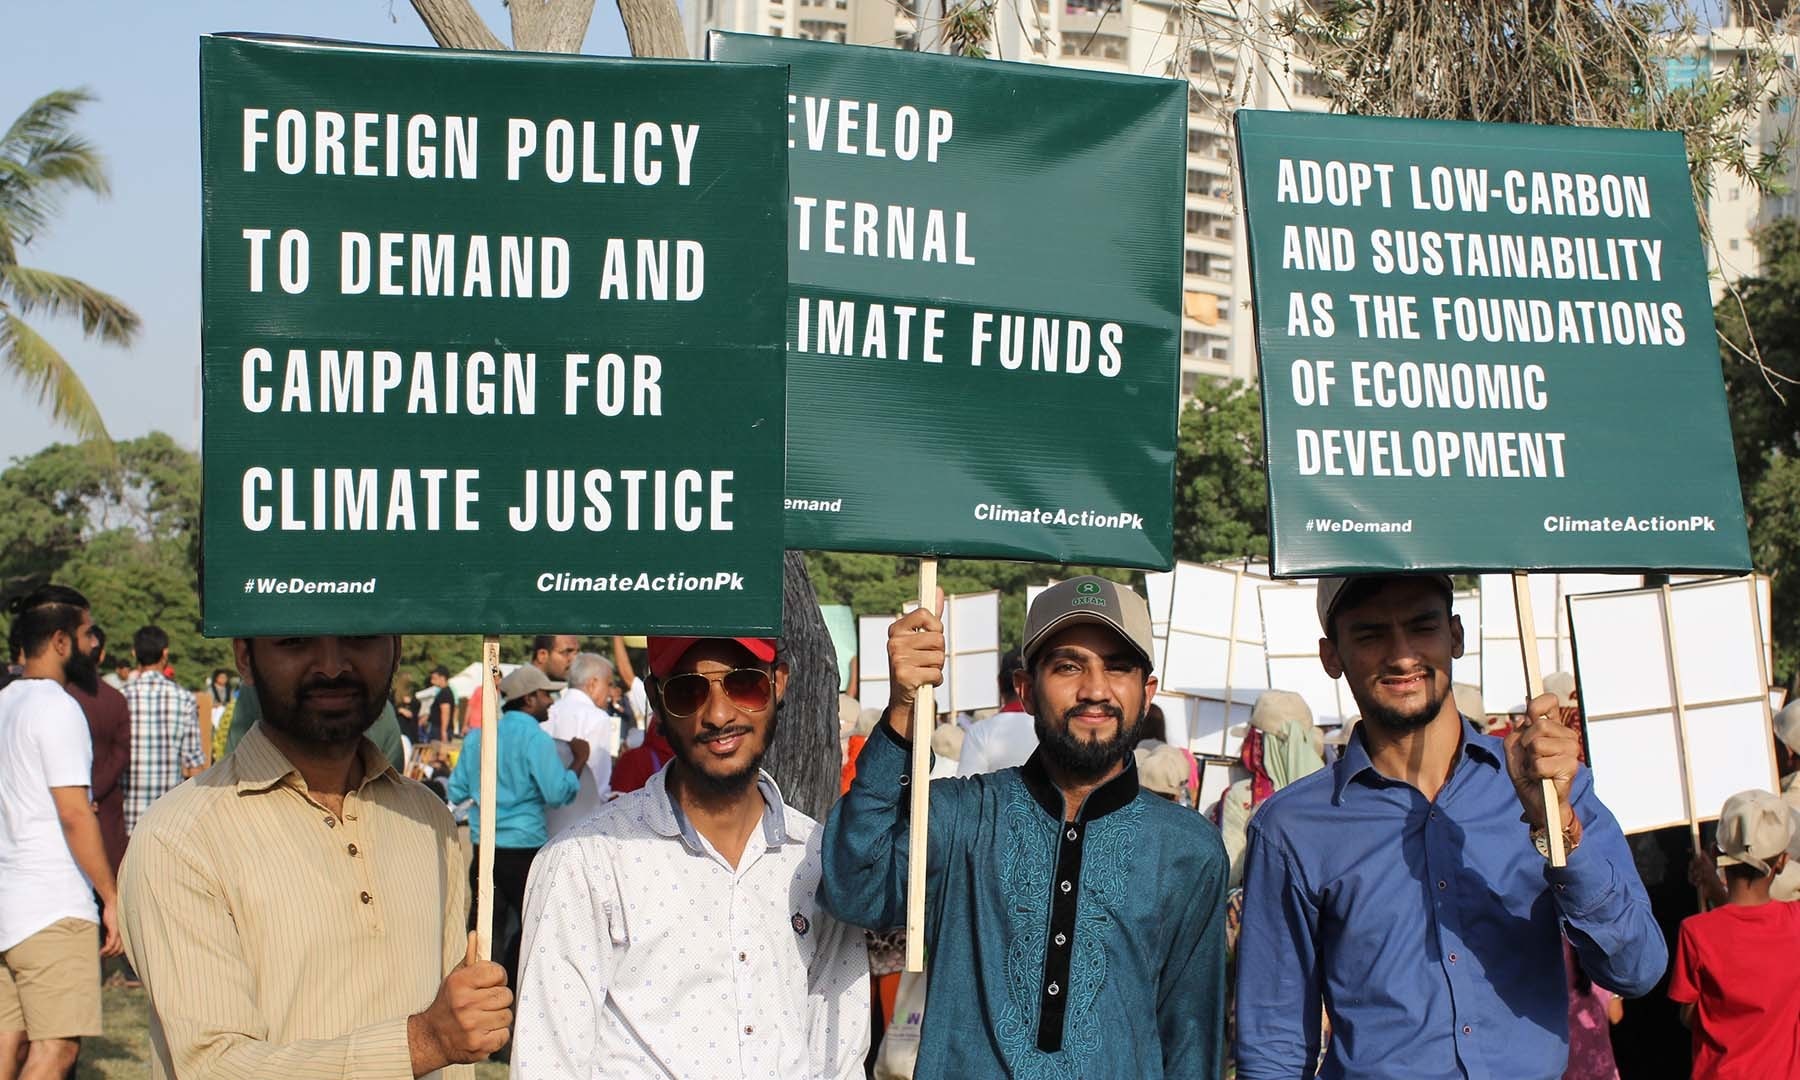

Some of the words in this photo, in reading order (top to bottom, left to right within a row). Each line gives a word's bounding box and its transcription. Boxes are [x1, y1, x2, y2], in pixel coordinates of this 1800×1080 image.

[243, 108, 478, 180] FOREIGN
[507, 118, 700, 186] POLICY
[1277, 158, 1394, 208] ADOPT
[1409, 165, 1651, 219] LOW-CARBON
[242, 228, 310, 295] TO
[341, 231, 570, 299] DEMAND
[599, 238, 705, 301] AND
[1282, 224, 1356, 272] AND
[1370, 228, 1662, 282] SUSTAINABILITY
[786, 297, 945, 364] IMATE
[971, 312, 1123, 378] FUNDS
[1287, 291, 1336, 338] AS
[1349, 294, 1421, 340] THE
[1432, 296, 1686, 347] FOUNDATIONS
[242, 347, 536, 416] CAMPAIGN
[565, 353, 662, 417] FOR
[1291, 358, 1336, 407] OF
[1350, 360, 1548, 411] ECONOMIC
[1295, 428, 1566, 478] DEVELOPMENT
[242, 466, 480, 532] CLIMATE
[508, 468, 734, 532] JUSTICE
[974, 503, 1144, 531] ClimateActionPk
[1305, 518, 1413, 533] #WeDemand
[1543, 515, 1716, 532] ClimateActionPk
[244, 577, 376, 594] #WeDemand
[536, 572, 744, 592] ClimateActionPk
[1072, 596, 1106, 607] OXFAM
